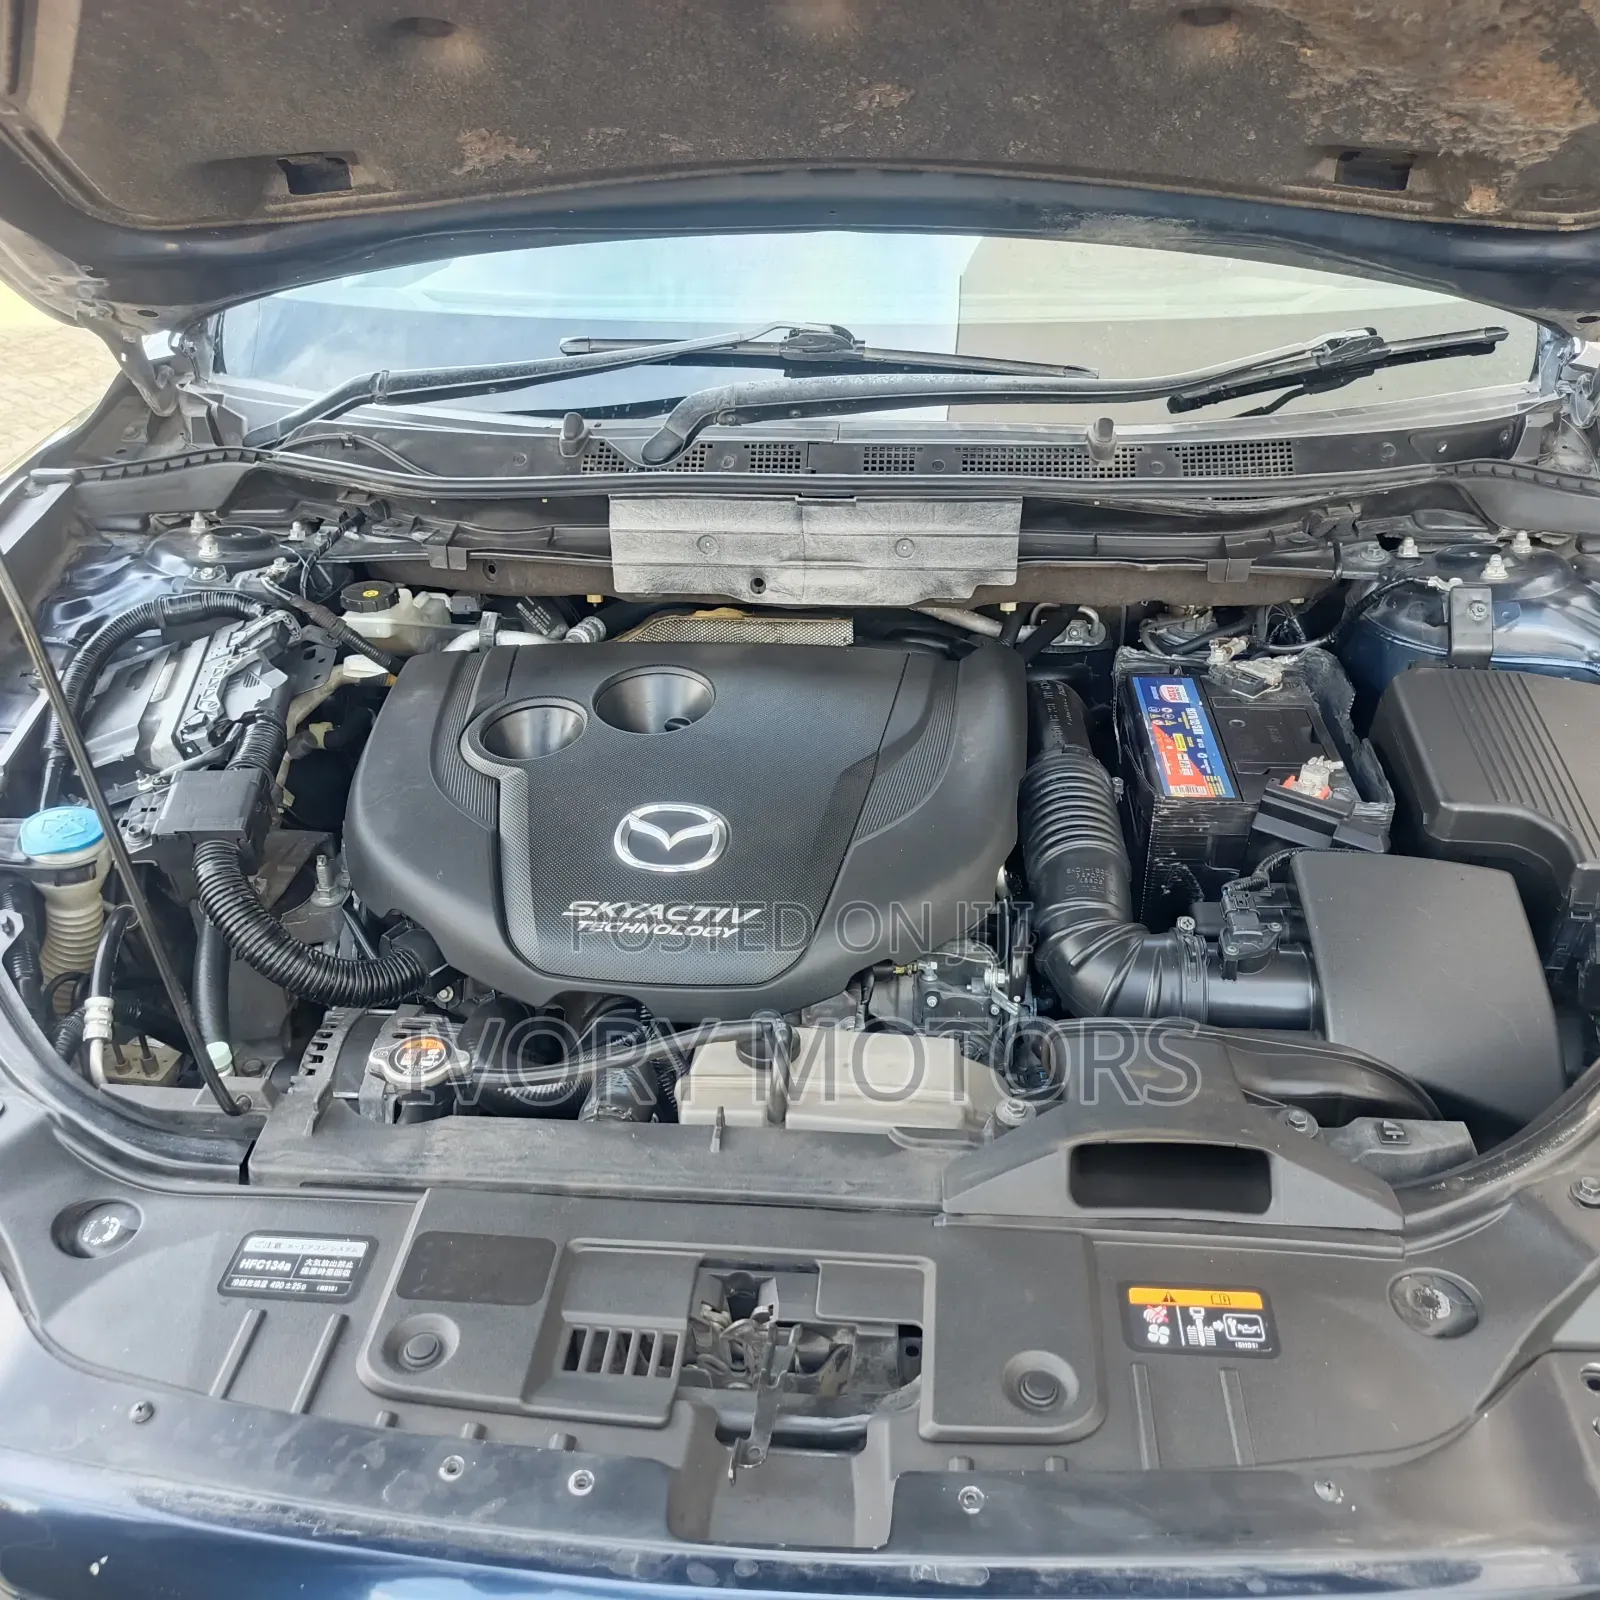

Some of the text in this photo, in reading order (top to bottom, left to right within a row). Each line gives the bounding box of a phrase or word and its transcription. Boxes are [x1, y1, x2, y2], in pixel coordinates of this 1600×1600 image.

[562, 901, 762, 924] SKYACTIV
[576, 920, 740, 938] TECHNOLOGY
[253, 1240, 283, 1250] ご注意
[239, 1258, 292, 1272] HFC134a
